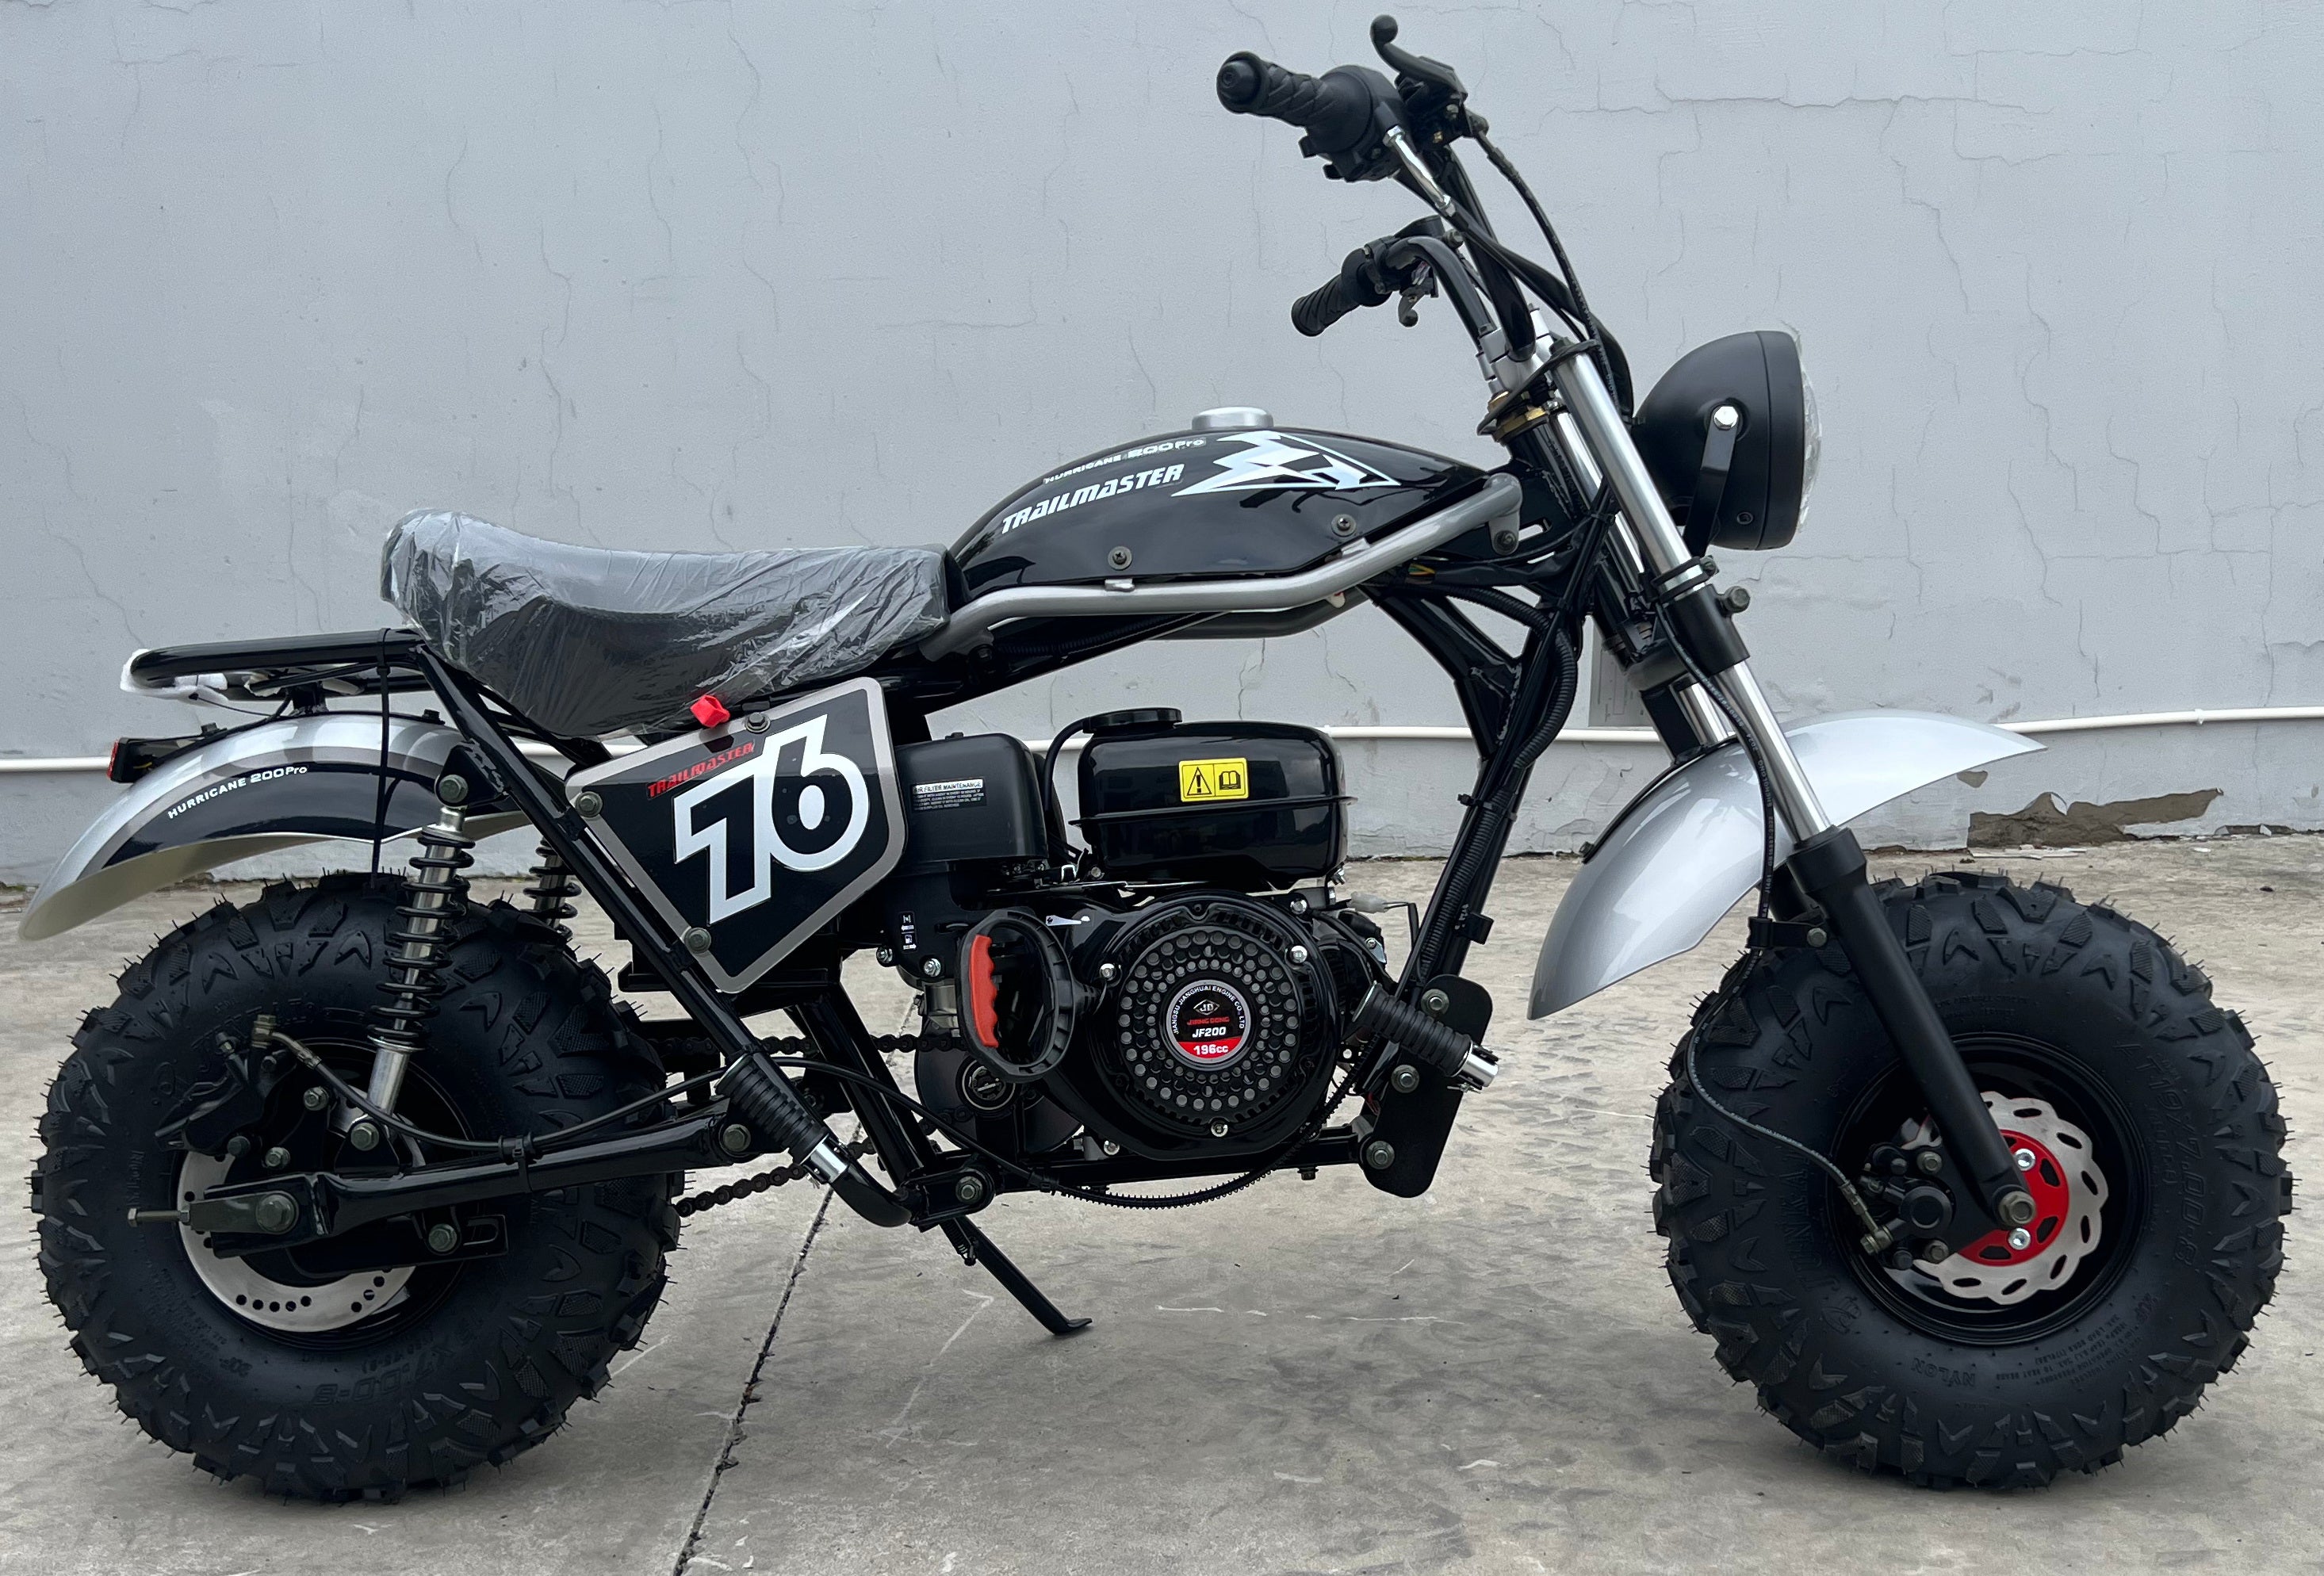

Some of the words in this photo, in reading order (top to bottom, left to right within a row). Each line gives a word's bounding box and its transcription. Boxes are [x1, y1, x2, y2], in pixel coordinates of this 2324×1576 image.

[1001, 463, 1185, 534] TRAILMASTER
[648, 741, 756, 798] TRAILMASTER
[167, 778, 247, 819] HURRICANE
[1212, 986, 1236, 1002] ENGINE
[1192, 1027, 1227, 1038] JF200
[1193, 1044, 1229, 1055] 196cc
[1910, 1356, 1976, 1387] NYLON
